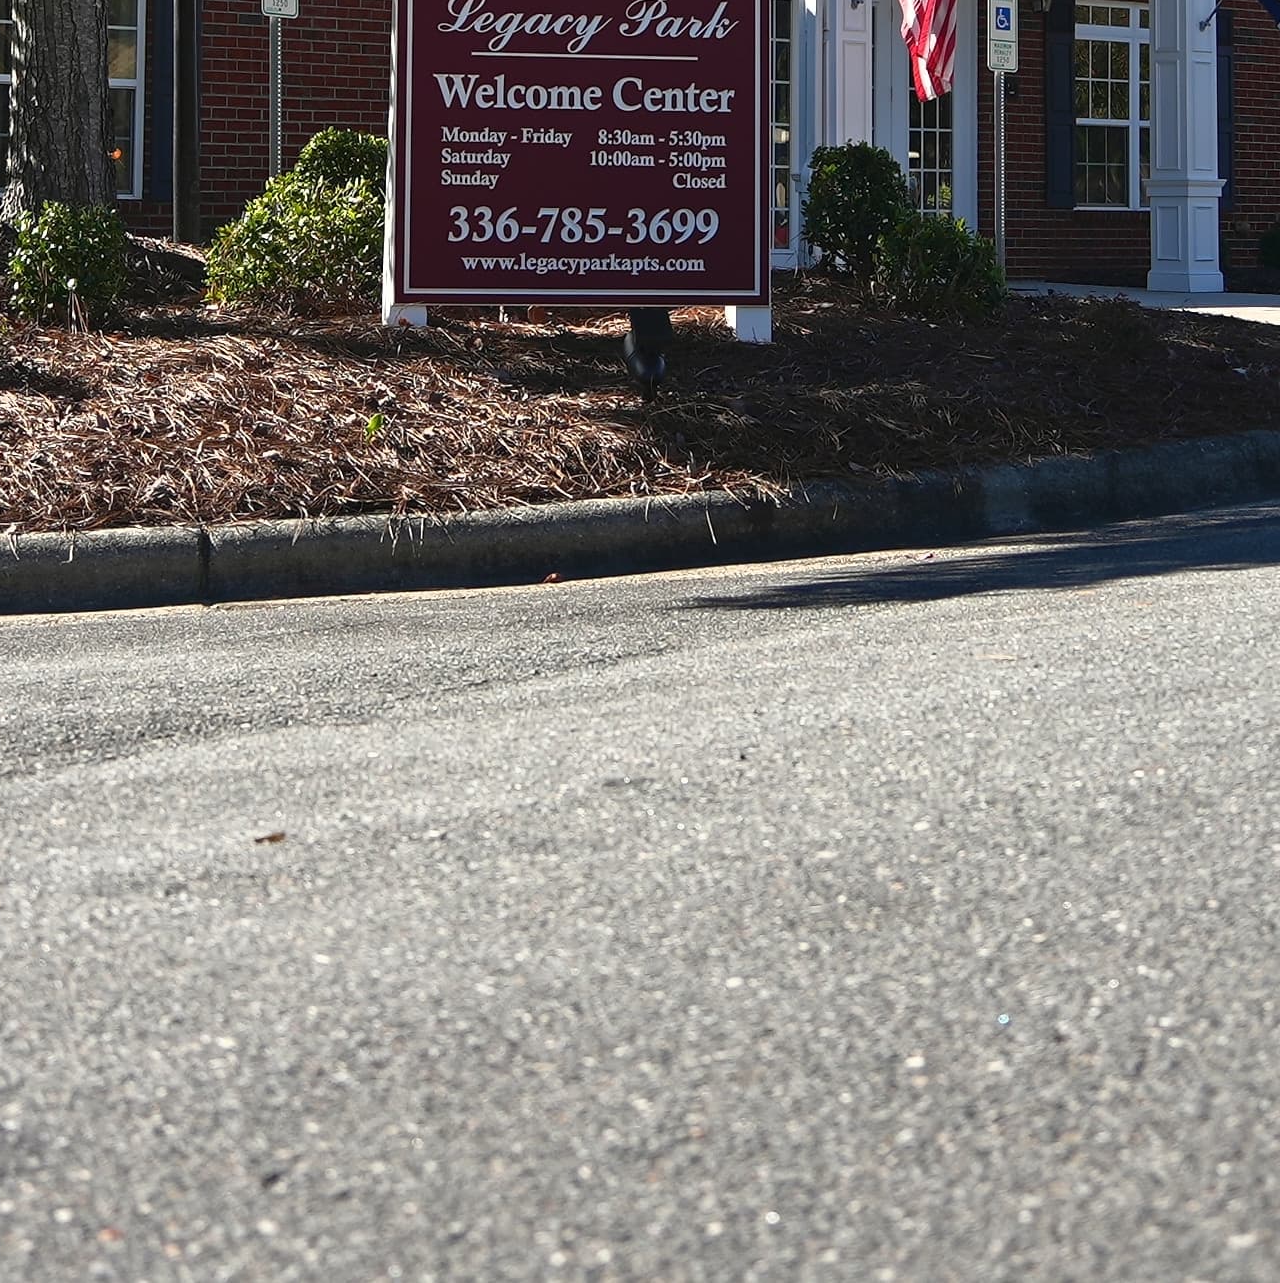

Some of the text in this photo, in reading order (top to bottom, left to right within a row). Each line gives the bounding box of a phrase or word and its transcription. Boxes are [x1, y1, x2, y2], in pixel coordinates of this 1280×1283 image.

[433, 74, 735, 112] Welcome Center
[442, 127, 507, 146] Monday
[521, 128, 572, 147] Friday
[598, 129, 655, 146] 8:30am
[669, 131, 726, 148] 5:30pm
[442, 148, 511, 168] Saturday
[590, 150, 655, 167] 10:00am
[669, 152, 726, 170] 5:00pm
[441, 170, 726, 189] Sunday Closed
[448, 206, 719, 244] 336-785-3699
[462, 253, 705, 275] www.legacyparkapts.com
